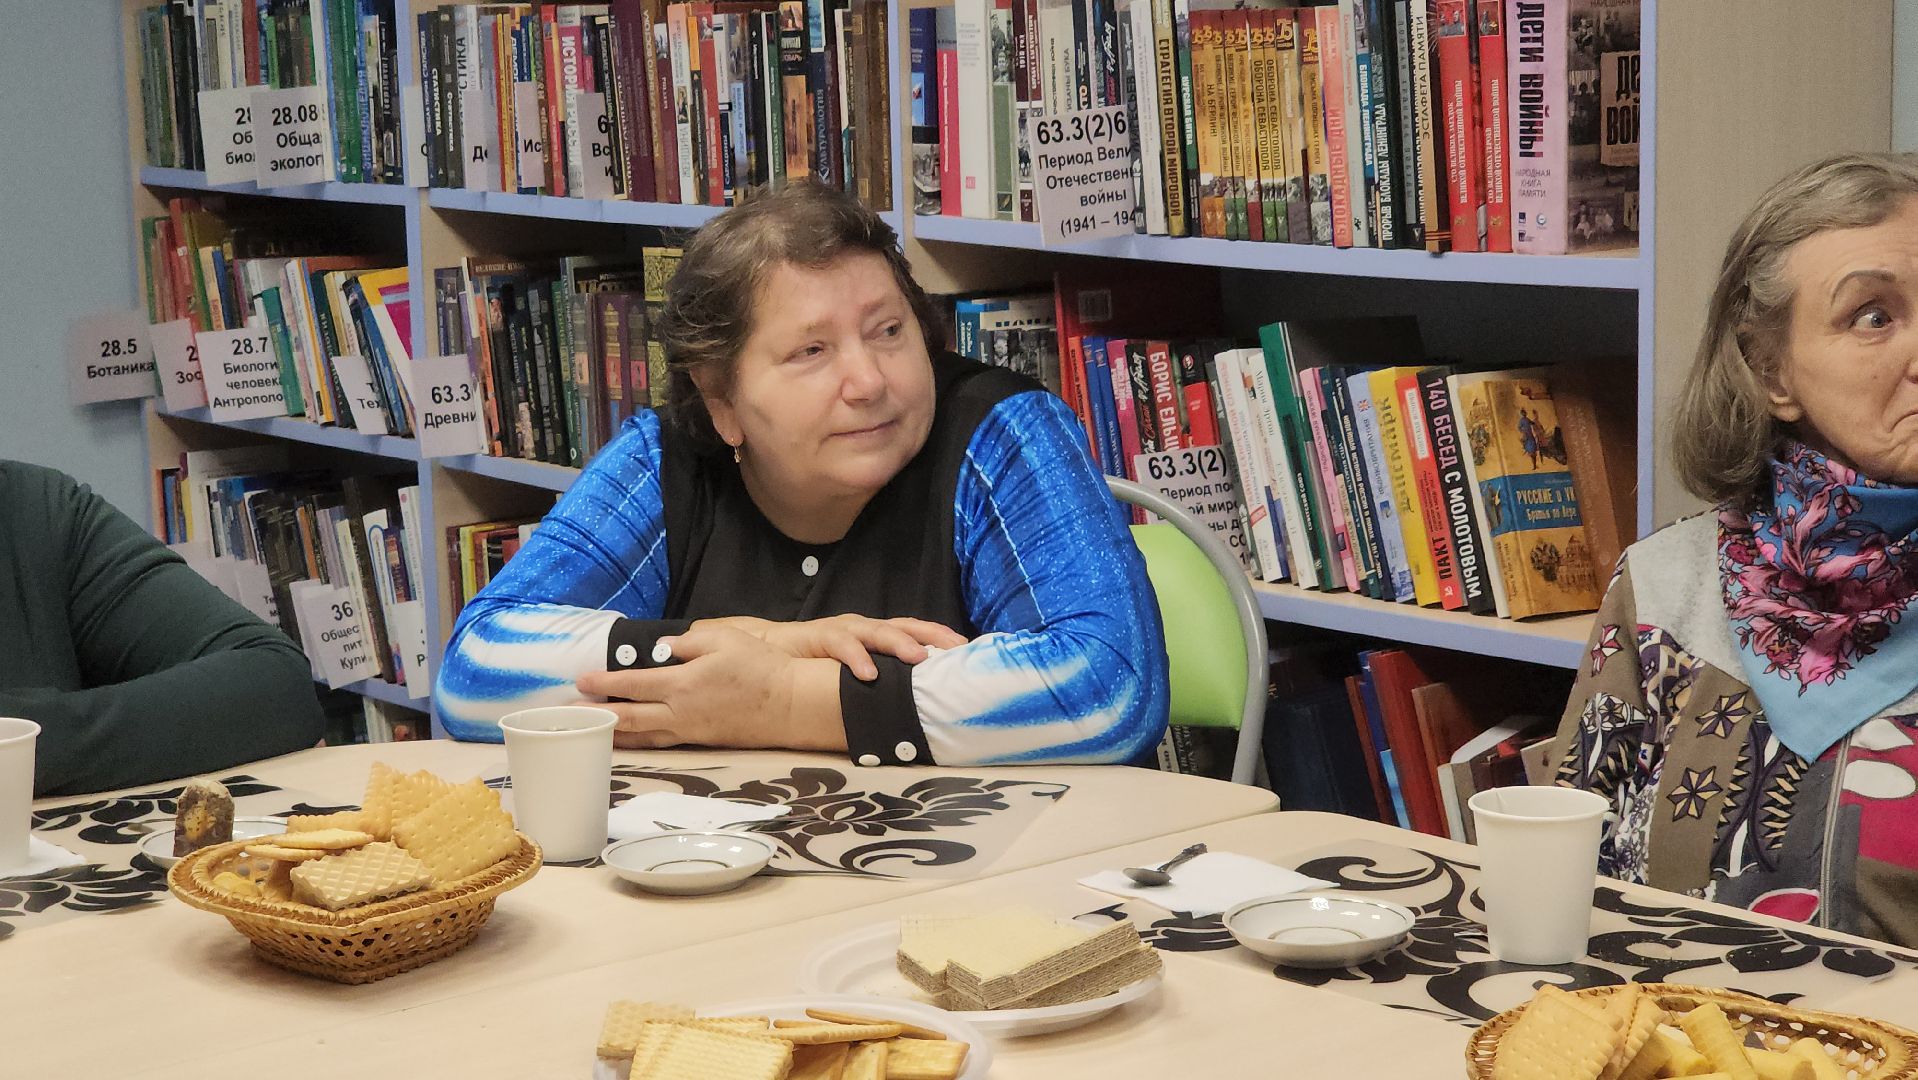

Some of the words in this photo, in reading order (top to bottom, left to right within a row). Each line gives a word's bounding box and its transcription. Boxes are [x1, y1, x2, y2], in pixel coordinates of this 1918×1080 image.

[1416, 15, 1428, 71] ПАМЯТИ
[1158, 39, 1173, 105] СТРАТЕГИЯ
[1206, 84, 1214, 96] НА
[1253, 60, 1264, 104] ОБОРОНА
[1266, 59, 1276, 103] ОБОРОНА
[1359, 64, 1370, 107] БЛОКАДА
[271, 104, 319, 126] 28.08
[1207, 98, 1217, 137] БЕРЛИН!
[1328, 108, 1344, 137] ДНИ
[1418, 73, 1431, 139] ЭСТАФЕТА
[1519, 74, 1550, 157] ВОЙНЫ
[276, 130, 323, 148] Обща
[1037, 111, 1127, 145] 63.3(2)6
[1162, 108, 1177, 156] ВТОРОЙ
[1257, 107, 1269, 171] СЕВАСТОПОЛЯ
[1269, 106, 1281, 170] СЕВАСТОПОЛЯ
[1361, 108, 1374, 166] ЛЕНИНГРАДА
[1374, 103, 1389, 157] ЛЕНИНГРАДА
[225, 152, 256, 165] био
[1038, 153, 1093, 170] Период
[1080, 189, 1127, 207] войны
[1166, 158, 1182, 217] МИРОВОЙ
[1330, 143, 1347, 236] БЛОКАДНЫЕ
[1378, 160, 1391, 203] БЛОКАДЫ
[1060, 215, 1096, 238] (1941
[1381, 206, 1394, 241] ПРОРЫВ
[101, 338, 137, 358] 28.5
[231, 336, 269, 356] 28.7
[87, 361, 155, 379] Ботаника
[1149, 351, 1173, 404] БОРИС
[431, 384, 471, 405] 63.3
[1425, 378, 1446, 411] 140
[1159, 406, 1180, 452] ЕЛЬЦ
[1432, 416, 1457, 469] БЕСЕД
[1148, 447, 1227, 480] 63.3(2)
[1444, 471, 1460, 484] С
[1516, 488, 1554, 505] РУССКИЕ
[1431, 536, 1453, 580] ПАКТ
[1449, 488, 1482, 598] МОЛОТОВЫМ
[331, 601, 354, 621] 36
